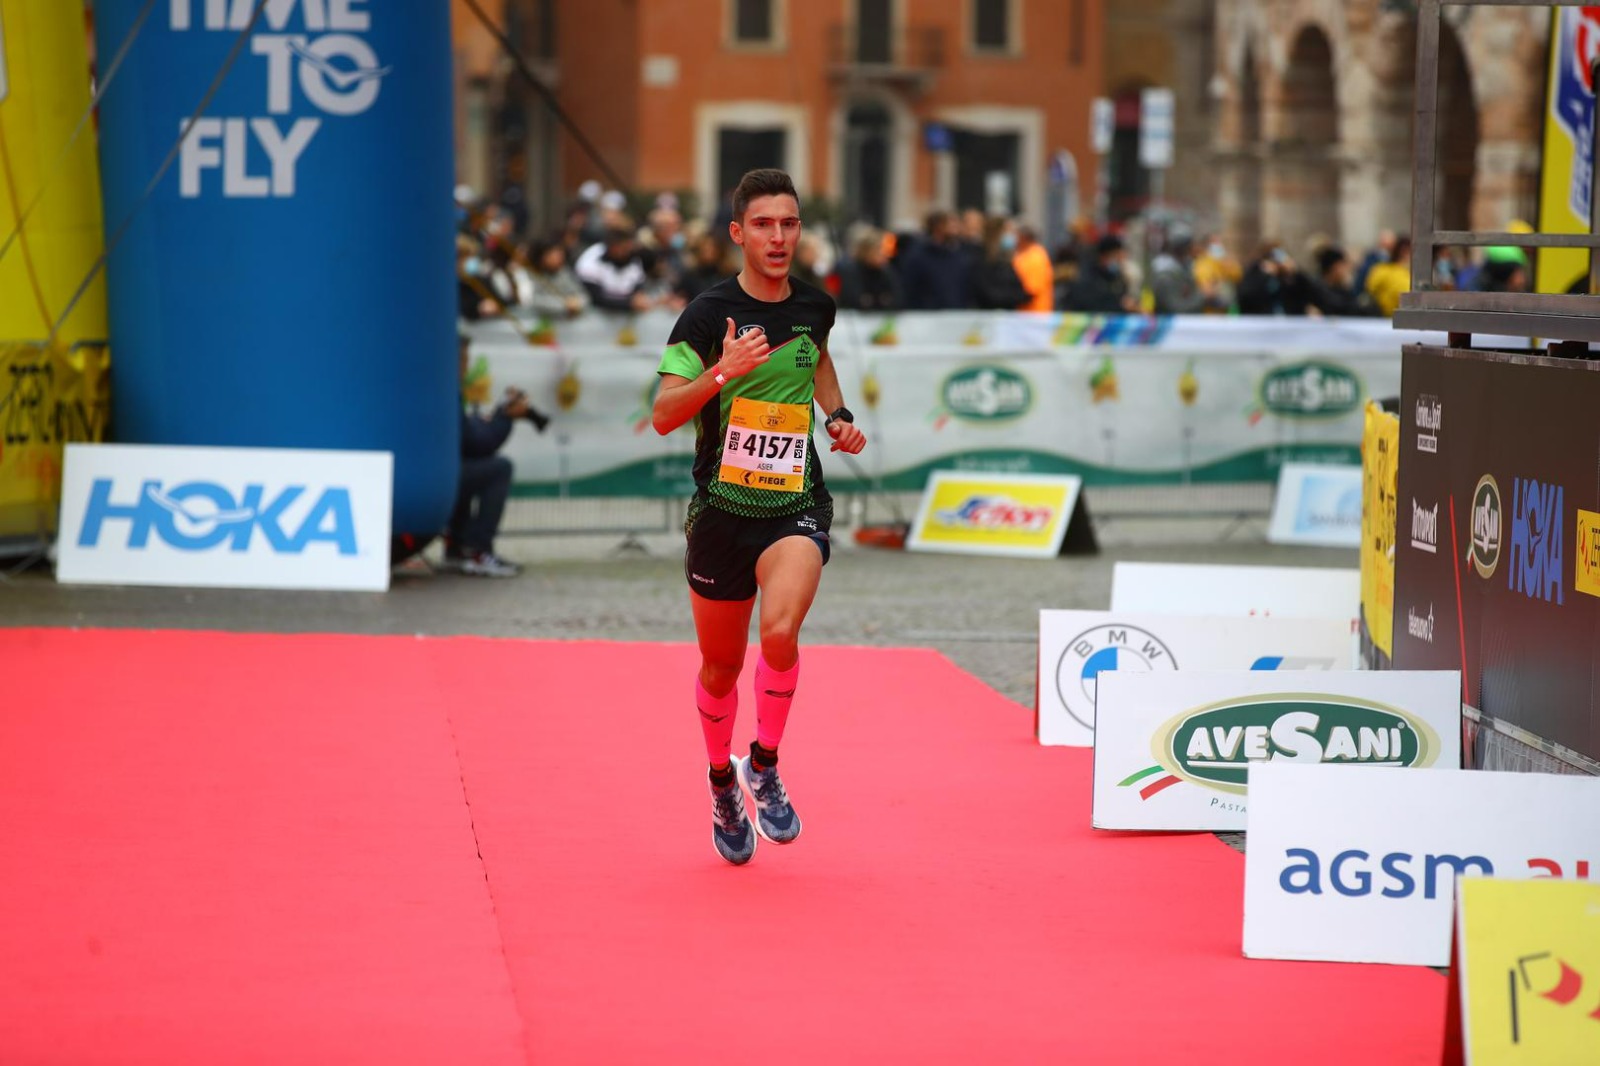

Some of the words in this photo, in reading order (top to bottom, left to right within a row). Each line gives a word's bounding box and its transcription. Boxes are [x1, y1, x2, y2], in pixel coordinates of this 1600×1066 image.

[251, 34, 382, 115] TO
[179, 118, 321, 197] FLY
[743, 433, 793, 460] 4157
[757, 463, 774, 471] ASIER
[758, 476, 786, 486] FIEGE
[77, 478, 359, 557] HOKA
[1508, 477, 1564, 605] HOKA
[1073, 629, 1163, 660] BMW
